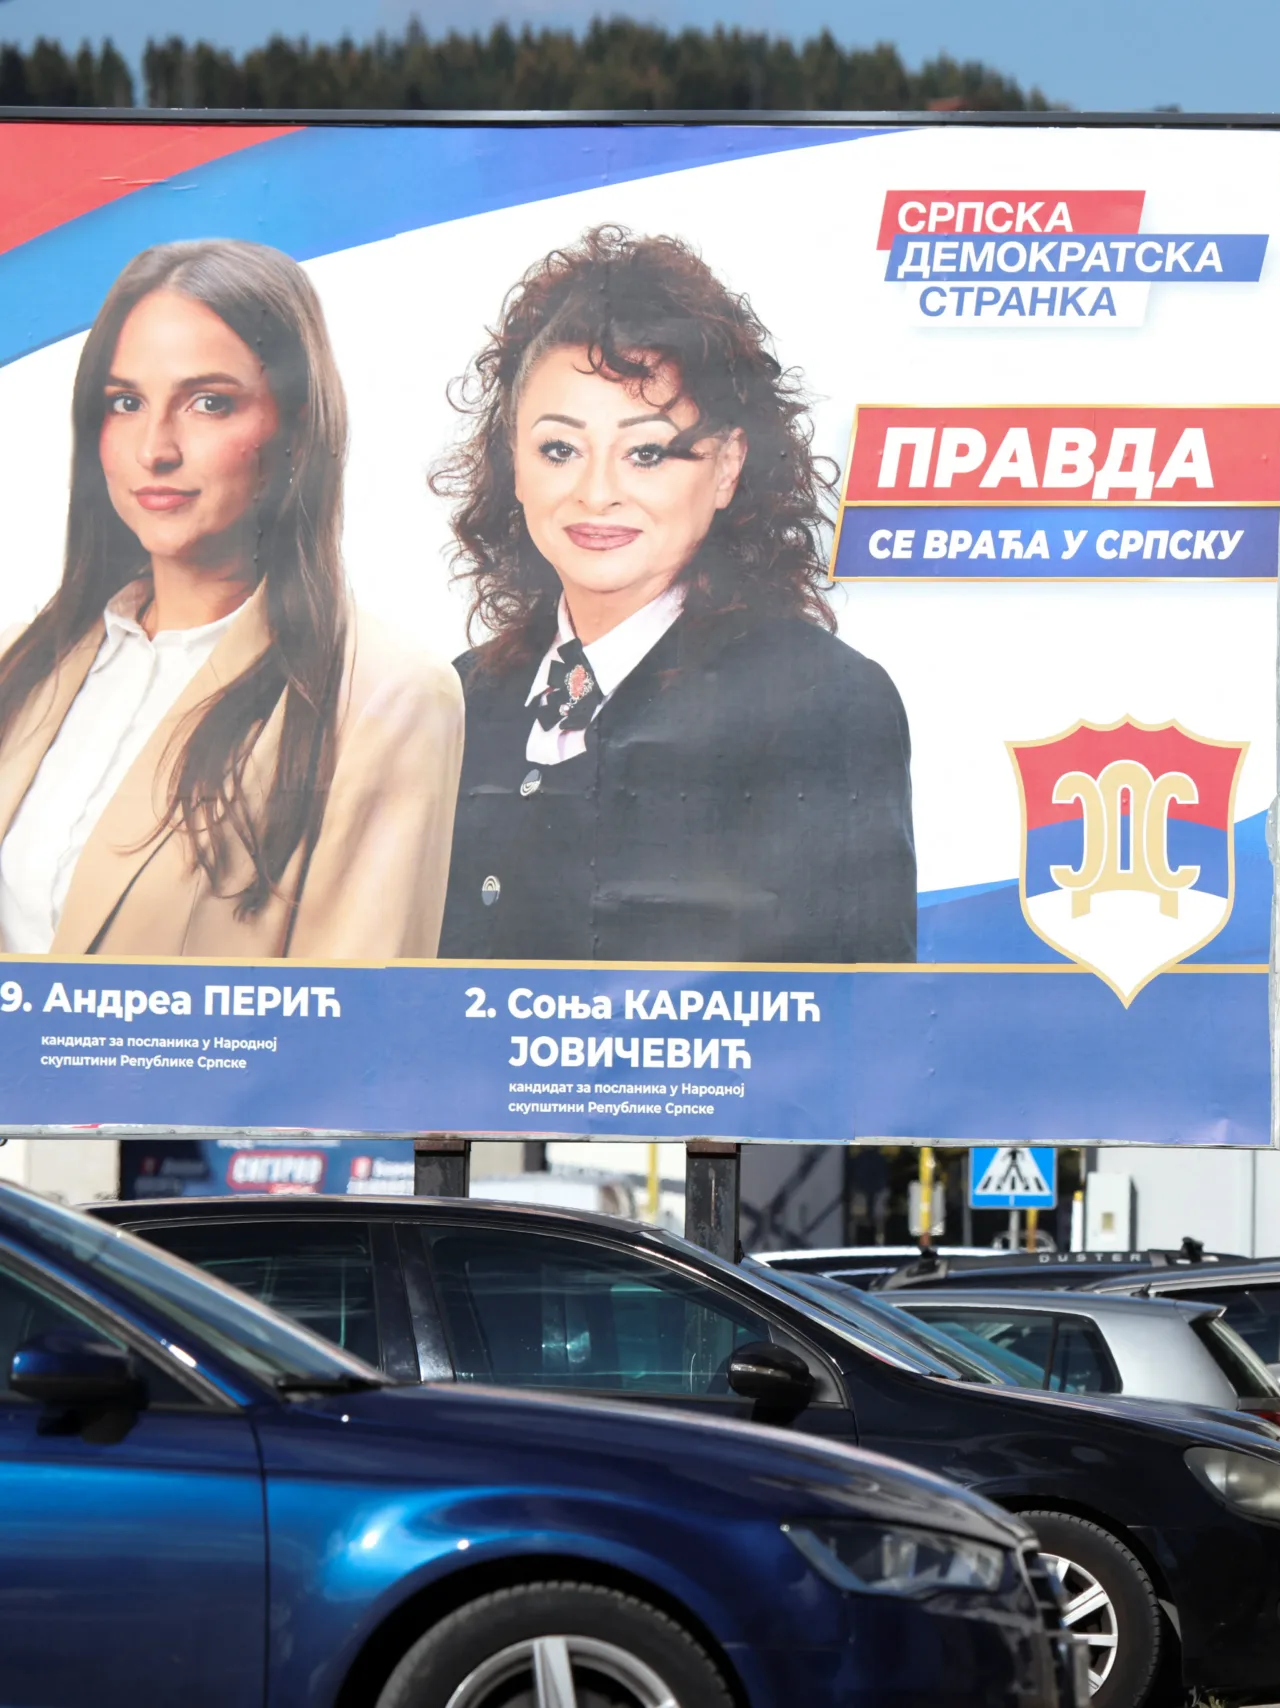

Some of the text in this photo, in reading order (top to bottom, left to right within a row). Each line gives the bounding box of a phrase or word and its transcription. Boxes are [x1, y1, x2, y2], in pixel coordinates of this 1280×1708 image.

[897, 201, 1074, 233] СРПСКА
[897, 241, 1224, 279] ДЕМОКРАТСКА
[919, 286, 1118, 317] СТРАНКА
[877, 427, 1215, 500] ПРАВДА
[868, 529, 1244, 560] СЕ ВРАЋА У СРПСКУ
[0, 981, 341, 1022] 9. Андреа ПЕРИЋ
[464, 987, 820, 1027] 2. Соња КАРАЏИЋ
[41, 1034, 277, 1051] кандидат за посланика у Народној
[508, 1036, 751, 1069] ЈОВИЧЕВИЋ
[41, 1054, 247, 1070] скупштини Републике Српске
[509, 1081, 745, 1098] кандидат за посланика у Народној
[508, 1101, 714, 1116] скупштини Републике Српске
[1038, 1253, 1142, 1263] DUSTER
